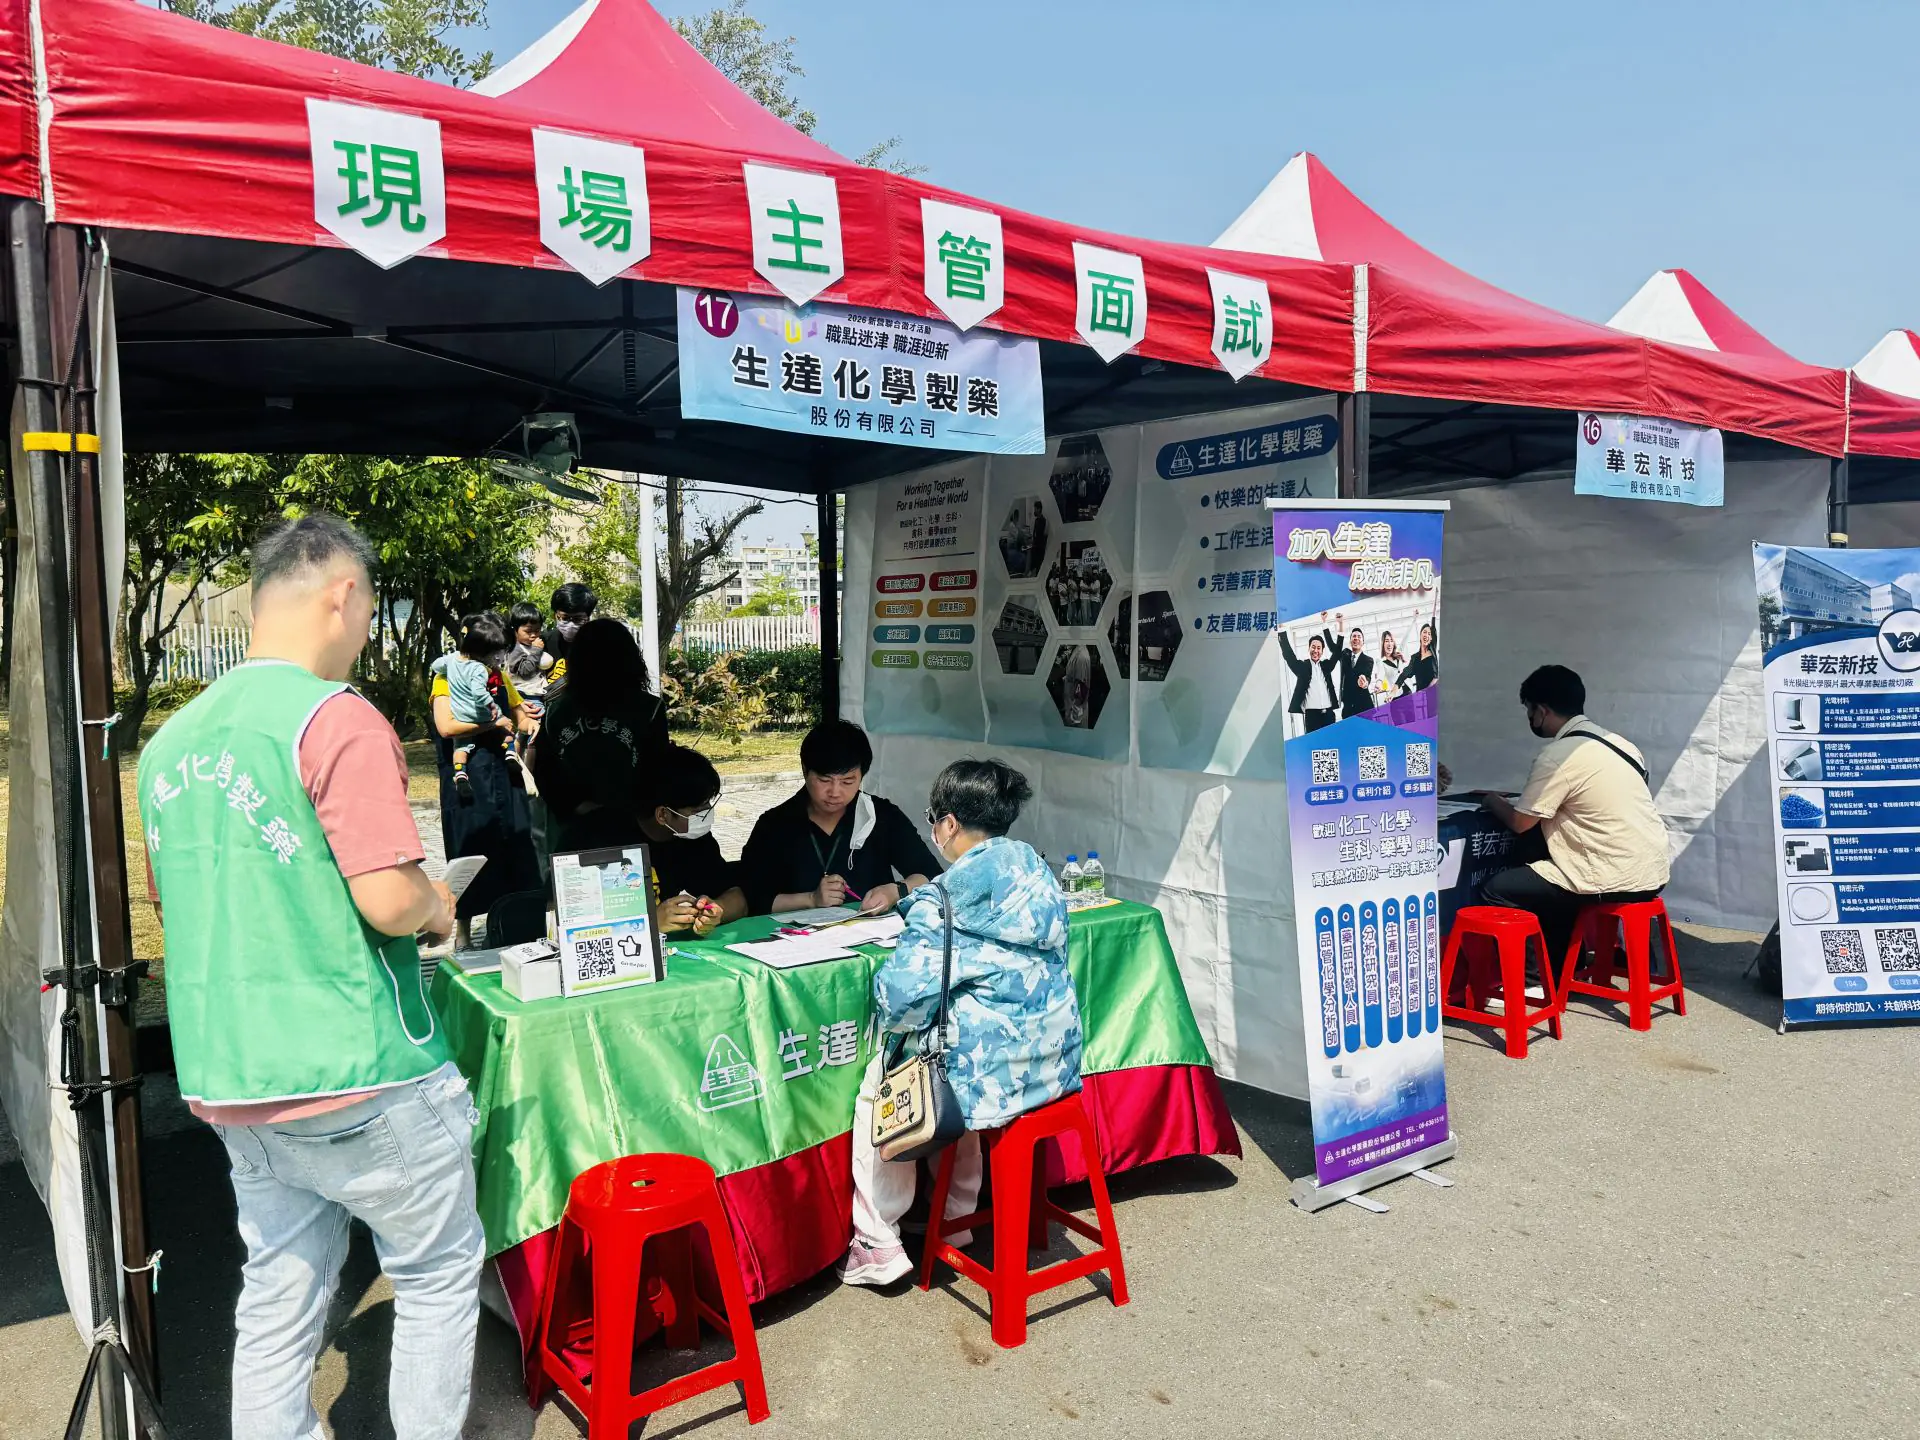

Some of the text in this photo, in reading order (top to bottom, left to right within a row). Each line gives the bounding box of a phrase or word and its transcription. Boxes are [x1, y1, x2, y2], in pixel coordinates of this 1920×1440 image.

[698, 292, 736, 330] 17
[847, 313, 932, 335] 2026 新營聯合徵才活動
[825, 323, 950, 361] 職點迷津 職涯迎新
[730, 346, 1000, 418] 生達化學製藥
[810, 405, 936, 439] 股份有限公司
[1583, 418, 1600, 441] 16
[1198, 423, 1324, 469] 生達化學製藥
[1606, 448, 1696, 482] 華宏新技
[896, 500, 908, 511] For
[914, 494, 946, 509] Healthier
[947, 490, 969, 505] World
[904, 476, 965, 496] Working Together
[1214, 477, 1314, 510] 快樂的生達人
[1630, 481, 1681, 498] 股份有限公司
[1214, 525, 1274, 552] 工作生活
[1288, 522, 1391, 561] 加入生達
[1209, 568, 1274, 593] 完善薪資
[1349, 559, 1434, 590] 成就非凡
[1800, 654, 1879, 676] 華宏新技
[1312, 822, 1336, 839] 歡迎
[1339, 835, 1412, 863] 生科、藥學
[1340, 927, 1358, 1027] 藥品研發人員
[1363, 924, 1379, 1006] 分析研究員
[1319, 931, 1338, 1047] 品管化學分析師
[706, 1066, 751, 1088] 生達
